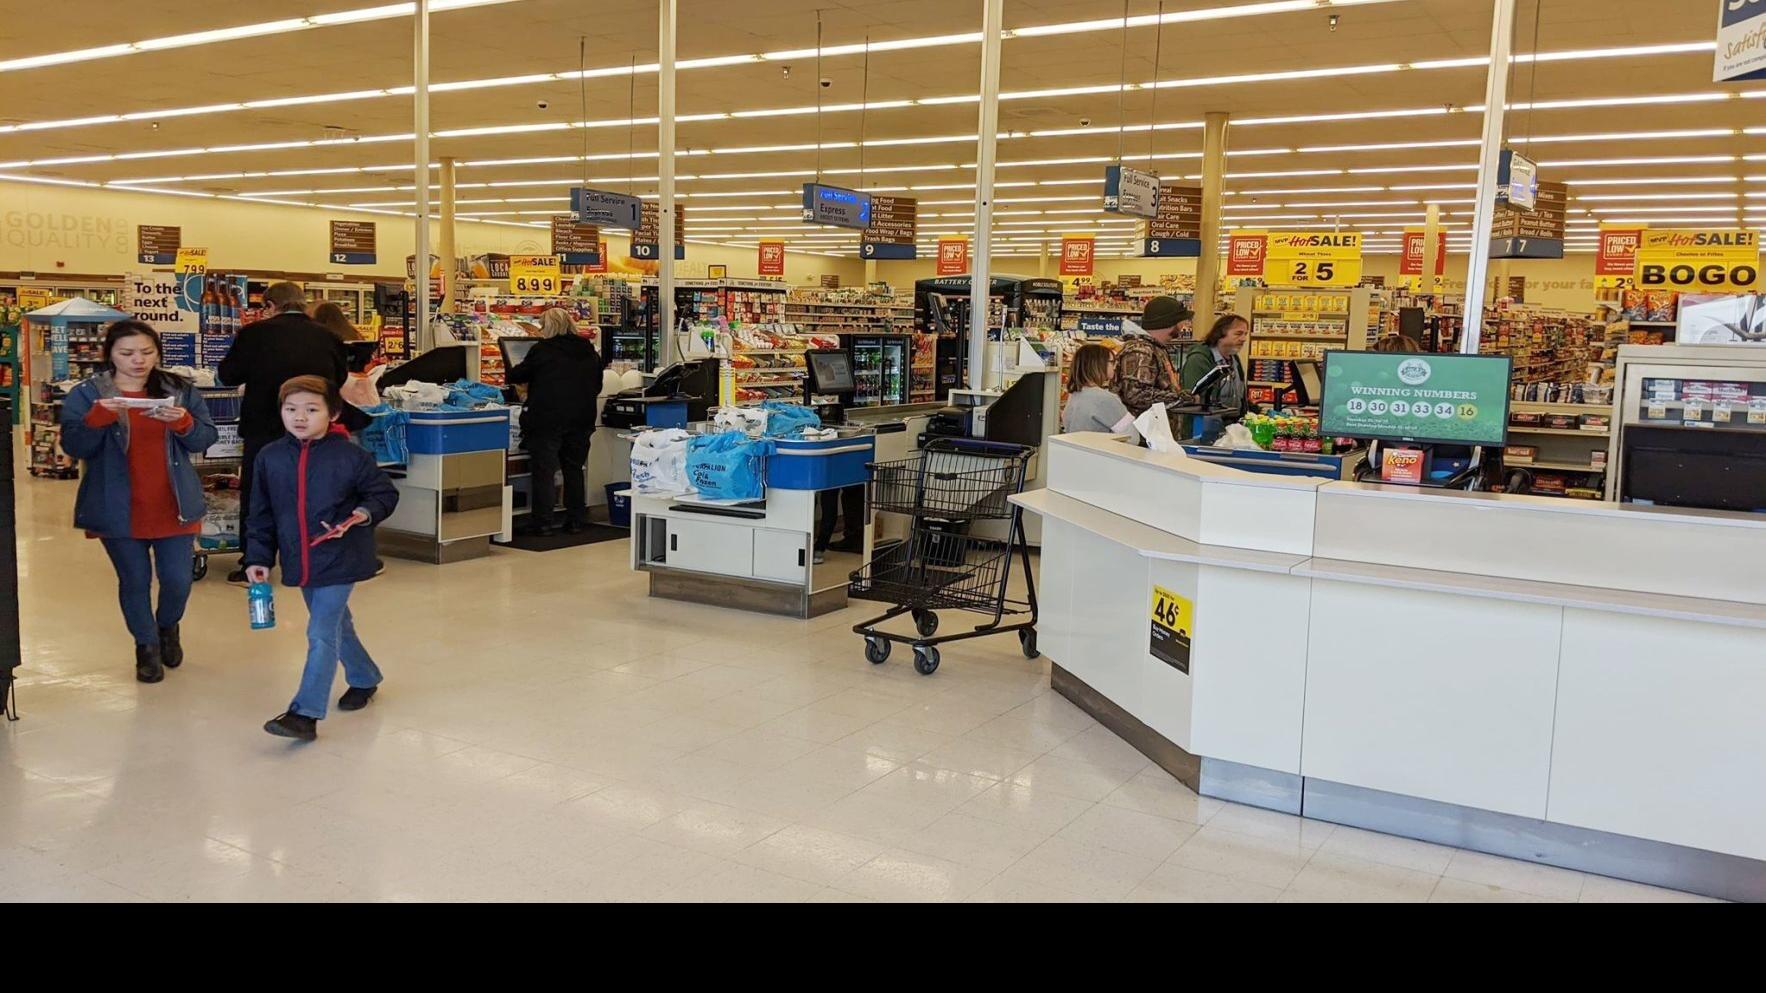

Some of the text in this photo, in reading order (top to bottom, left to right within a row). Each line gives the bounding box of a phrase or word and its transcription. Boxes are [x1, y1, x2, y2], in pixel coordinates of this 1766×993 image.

[1124, 172, 1150, 188] Full Service
[600, 194, 625, 204] Service
[1151, 186, 1158, 207] 3
[631, 203, 636, 221] 1
[820, 203, 847, 215] Express
[5, 211, 113, 234] GOLDEN
[7, 228, 112, 249] QUALITY
[1151, 230, 1170, 238] Cough
[1695, 232, 1754, 246] SALE!
[1236, 241, 1259, 249] PRICED
[1310, 235, 1356, 247] SALE!
[1506, 239, 1513, 253] 7
[1519, 239, 1527, 253] 7
[1607, 236, 1637, 245] PRICED
[635, 245, 651, 256] 10
[865, 244, 874, 255] 9
[1150, 240, 1160, 253] 8
[1606, 245, 1625, 253] LOW
[334, 254, 347, 262] 12
[1067, 249, 1080, 257] LOW
[143, 255, 155, 263] 13
[531, 257, 557, 266] SALE!
[490, 262, 509, 272] LOCA
[1295, 262, 1334, 281] 2 5
[1641, 264, 1757, 286] BOGO
[134, 282, 181, 294] To the
[1543, 280, 1579, 291] your
[134, 297, 168, 308] next
[134, 311, 184, 322] round.
[1081, 322, 1104, 330] Taste
[1351, 386, 1478, 400] WINNING NUMBERS
[1350, 401, 1474, 416] 18 30 31 33 34 16
[1387, 455, 1417, 465] Keno
